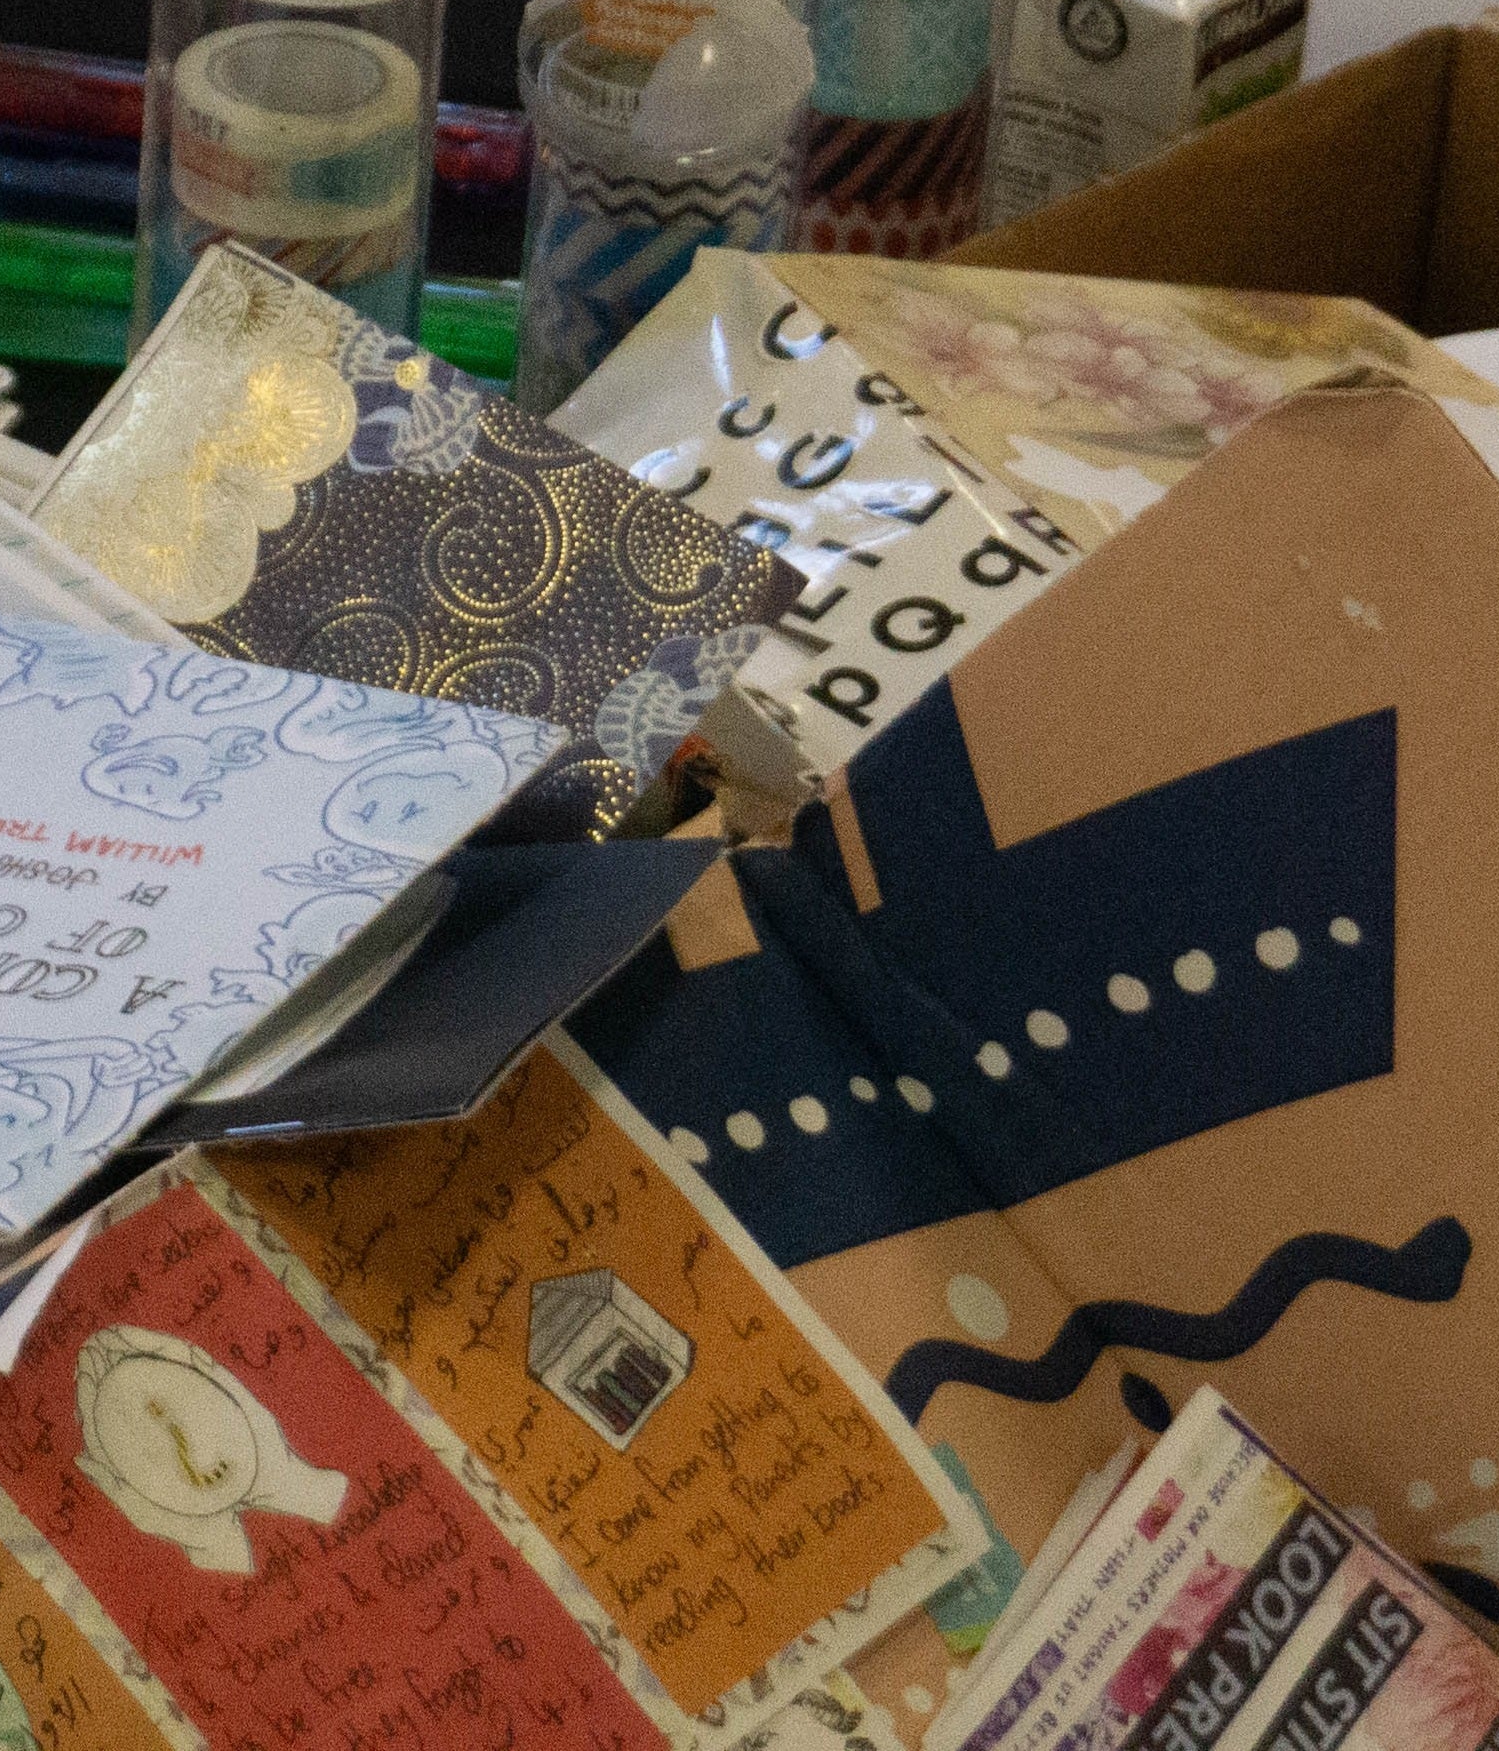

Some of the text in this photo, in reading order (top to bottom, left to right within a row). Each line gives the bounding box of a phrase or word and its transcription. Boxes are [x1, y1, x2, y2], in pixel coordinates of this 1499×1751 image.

[870, 595, 966, 655] Q
[54, 829, 207, 869] WILLIAM
[135, 882, 171, 907] BY
[45, 918, 150, 961] OF
[119, 972, 186, 1017] A
[556, 1346, 824, 1574] I come from getting to
[604, 1551, 682, 1615] know
[684, 1508, 749, 1564] my
[820, 1390, 882, 1451] by
[1185, 1505, 1212, 1538] OUR
[375, 1496, 472, 1592] dared
[1126, 1539, 1188, 1613] MOTHERS
[125, 1584, 237, 1703] They
[210, 1525, 310, 1616] sought
[642, 1576, 750, 1676] reading
[736, 1526, 807, 1583] their
[1056, 1537, 1136, 1643] THAN THAT
[1074, 1615, 1130, 1683] TAUGHT
[1152, 1517, 1338, 1751] LOOK PRE
[1345, 1596, 1421, 1688] SIT
[400, 1646, 497, 1723] forgot
[485, 1625, 528, 1664] to
[1053, 1680, 1075, 1709] US
[252, 1704, 313, 1745] be
